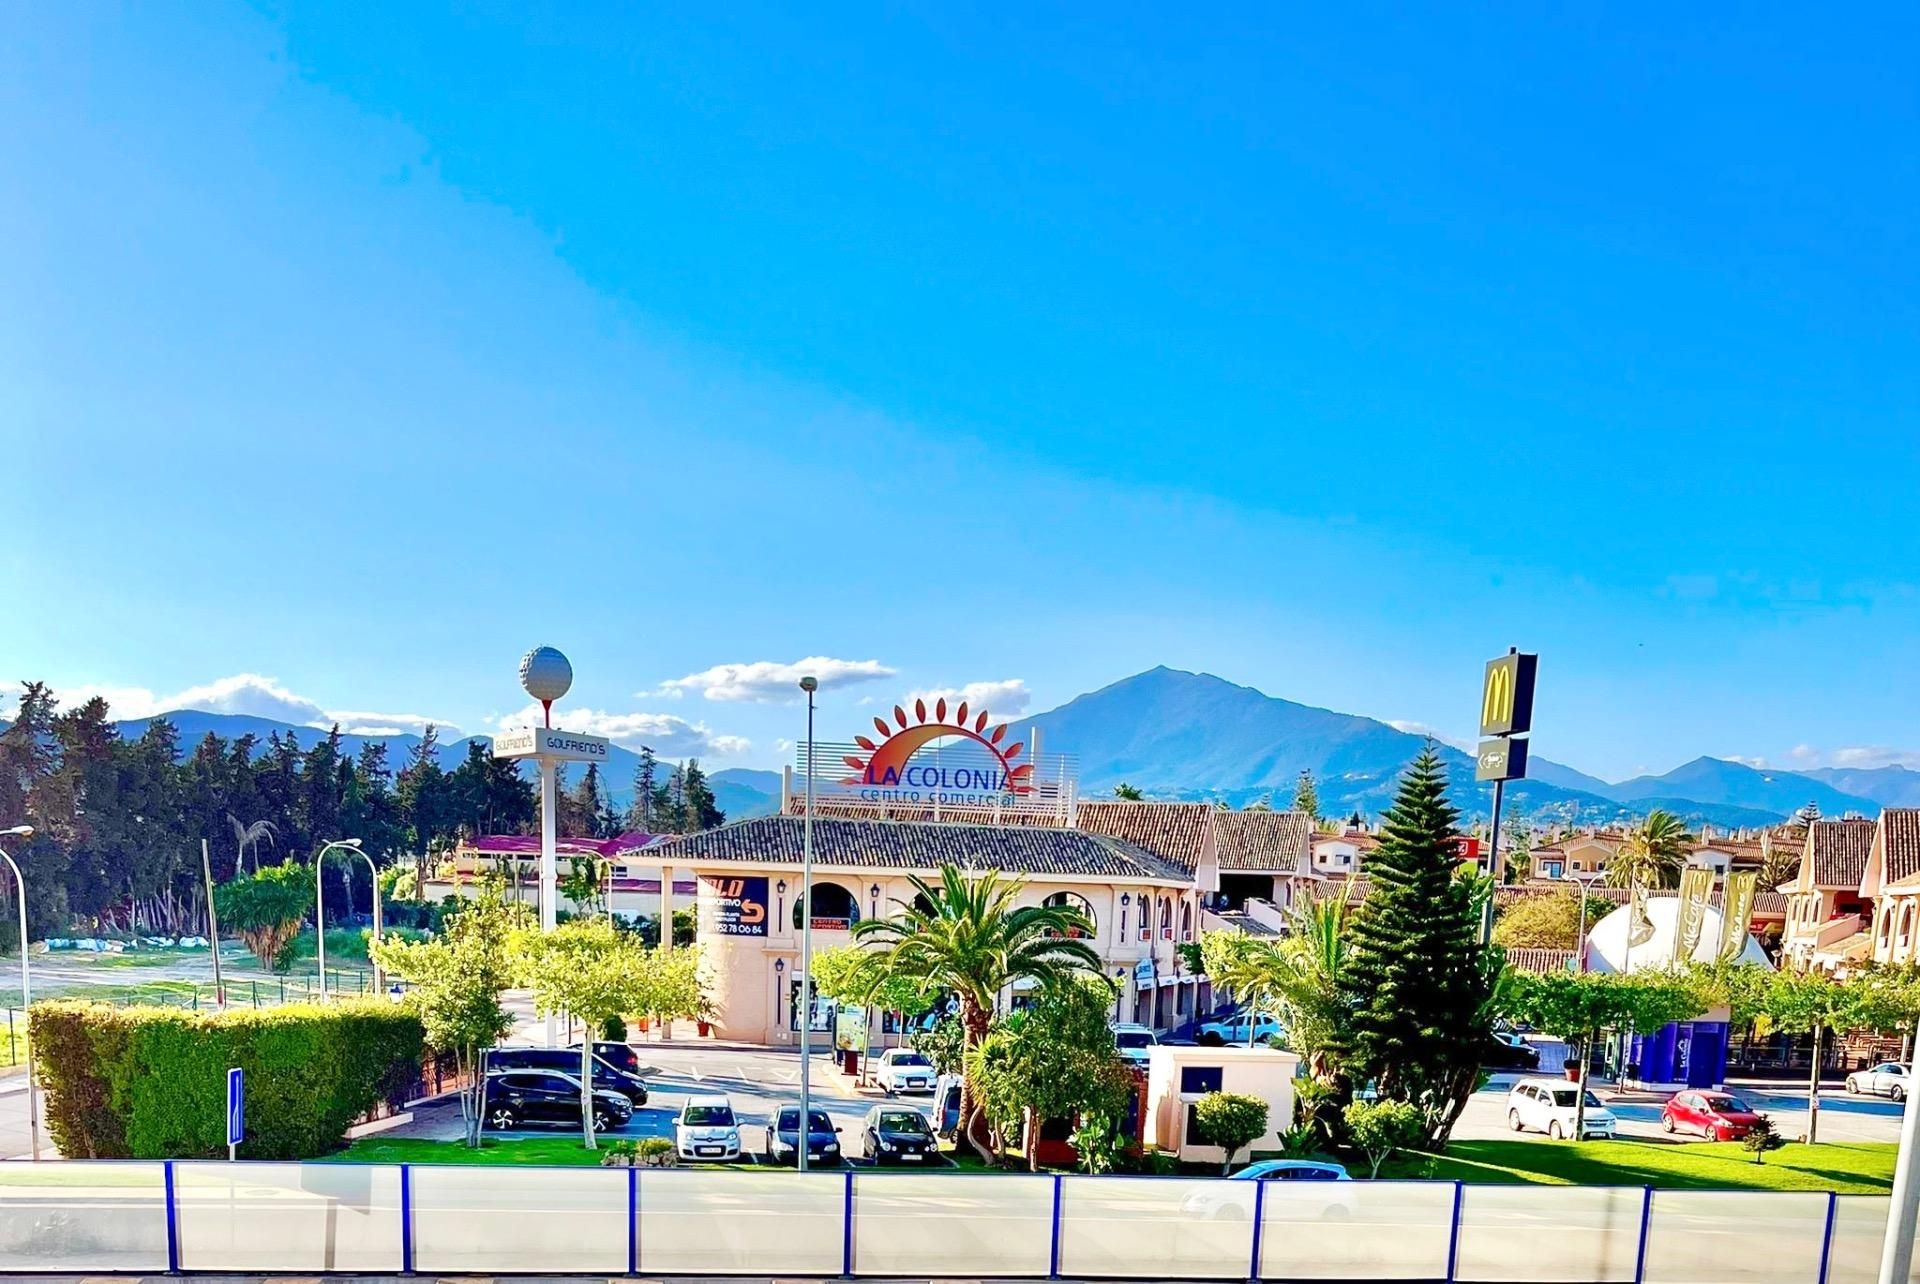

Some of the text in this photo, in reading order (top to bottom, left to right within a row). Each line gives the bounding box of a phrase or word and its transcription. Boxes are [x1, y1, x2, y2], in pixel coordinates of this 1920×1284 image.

[546, 737, 606, 755] GOLFRIEND'S
[868, 765, 901, 786] LA
[860, 788, 1016, 807] centro comercial
[728, 924, 738, 933] 78
[738, 925, 751, 934] 06
[752, 925, 763, 934] 84
